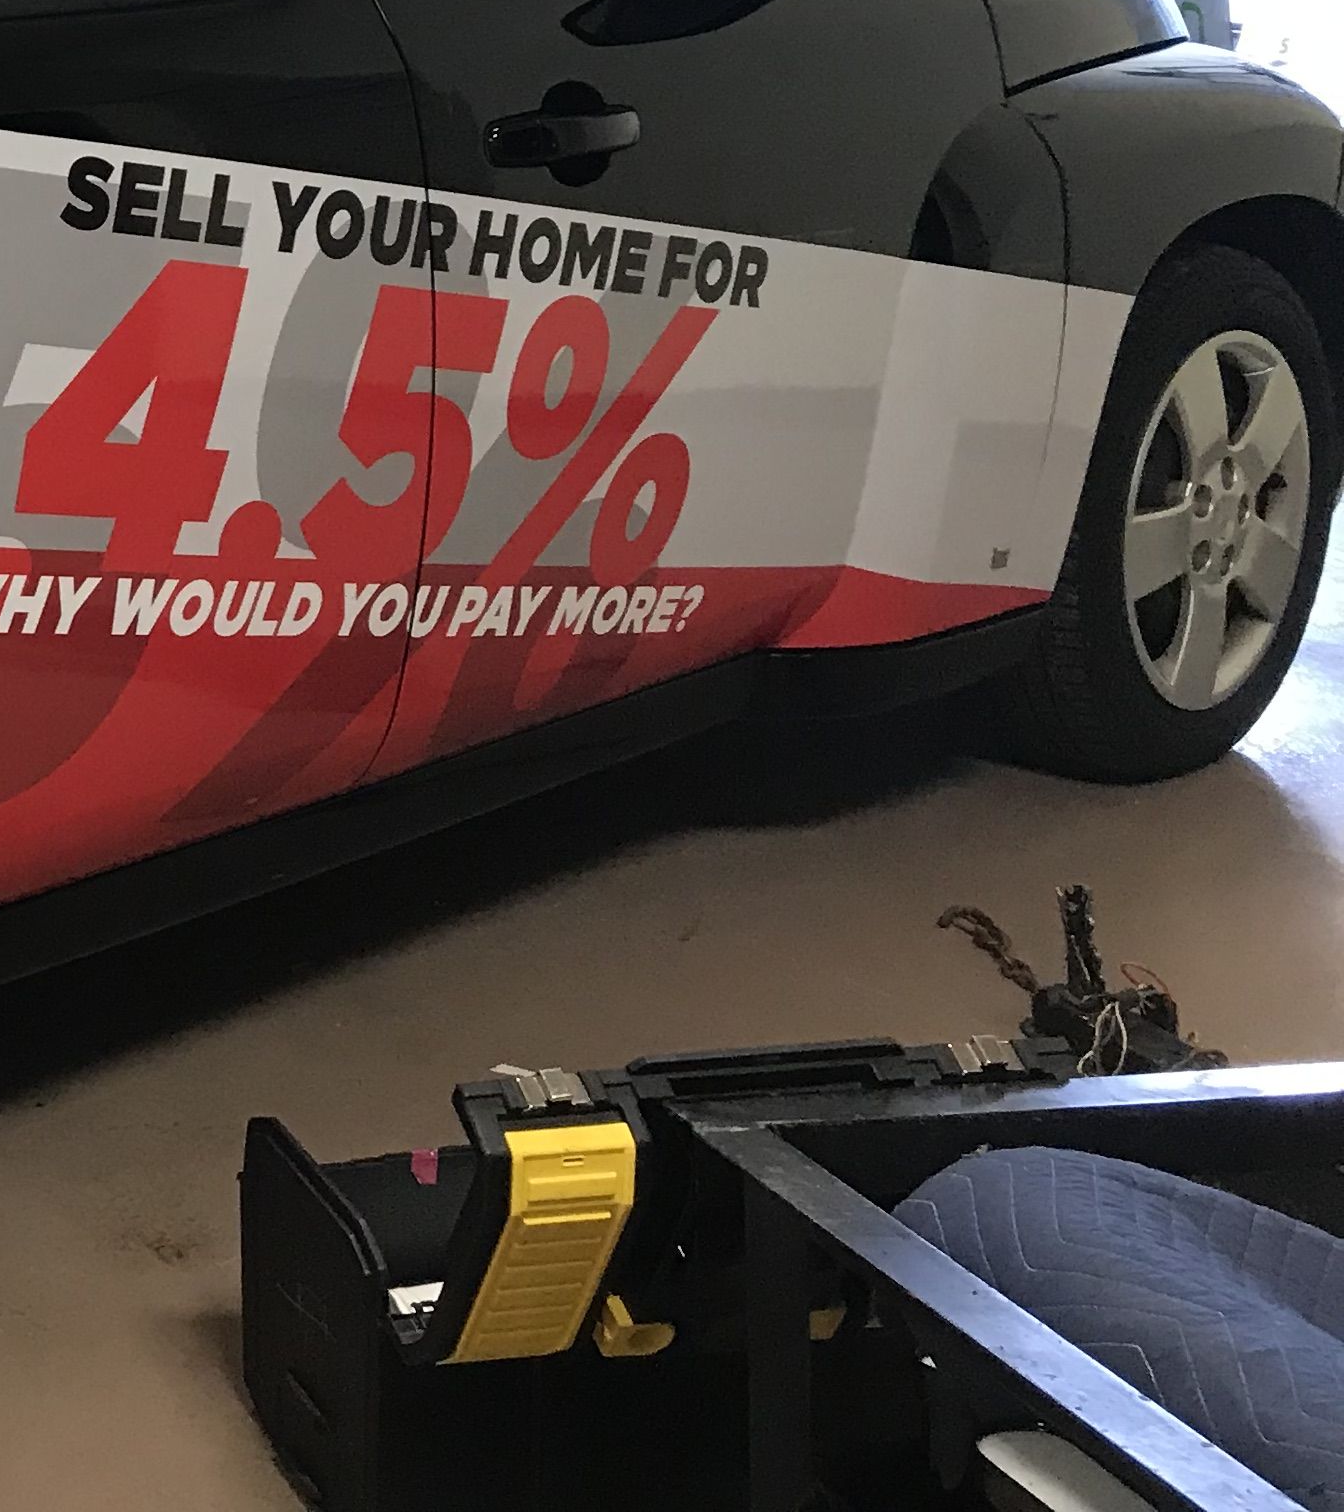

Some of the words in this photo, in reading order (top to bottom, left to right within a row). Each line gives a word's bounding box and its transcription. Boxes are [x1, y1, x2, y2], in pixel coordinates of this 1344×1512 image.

[60, 155, 245, 247] SELL
[272, 180, 457, 273] YOUR
[471, 208, 651, 294] HOME
[658, 235, 770, 308] FOR
[16, 259, 720, 583] 4.5%
[112, 572, 322, 638] WOULD
[337, 580, 449, 639] YOU
[447, 584, 552, 638] PAY
[553, 582, 705, 635] MORE?
